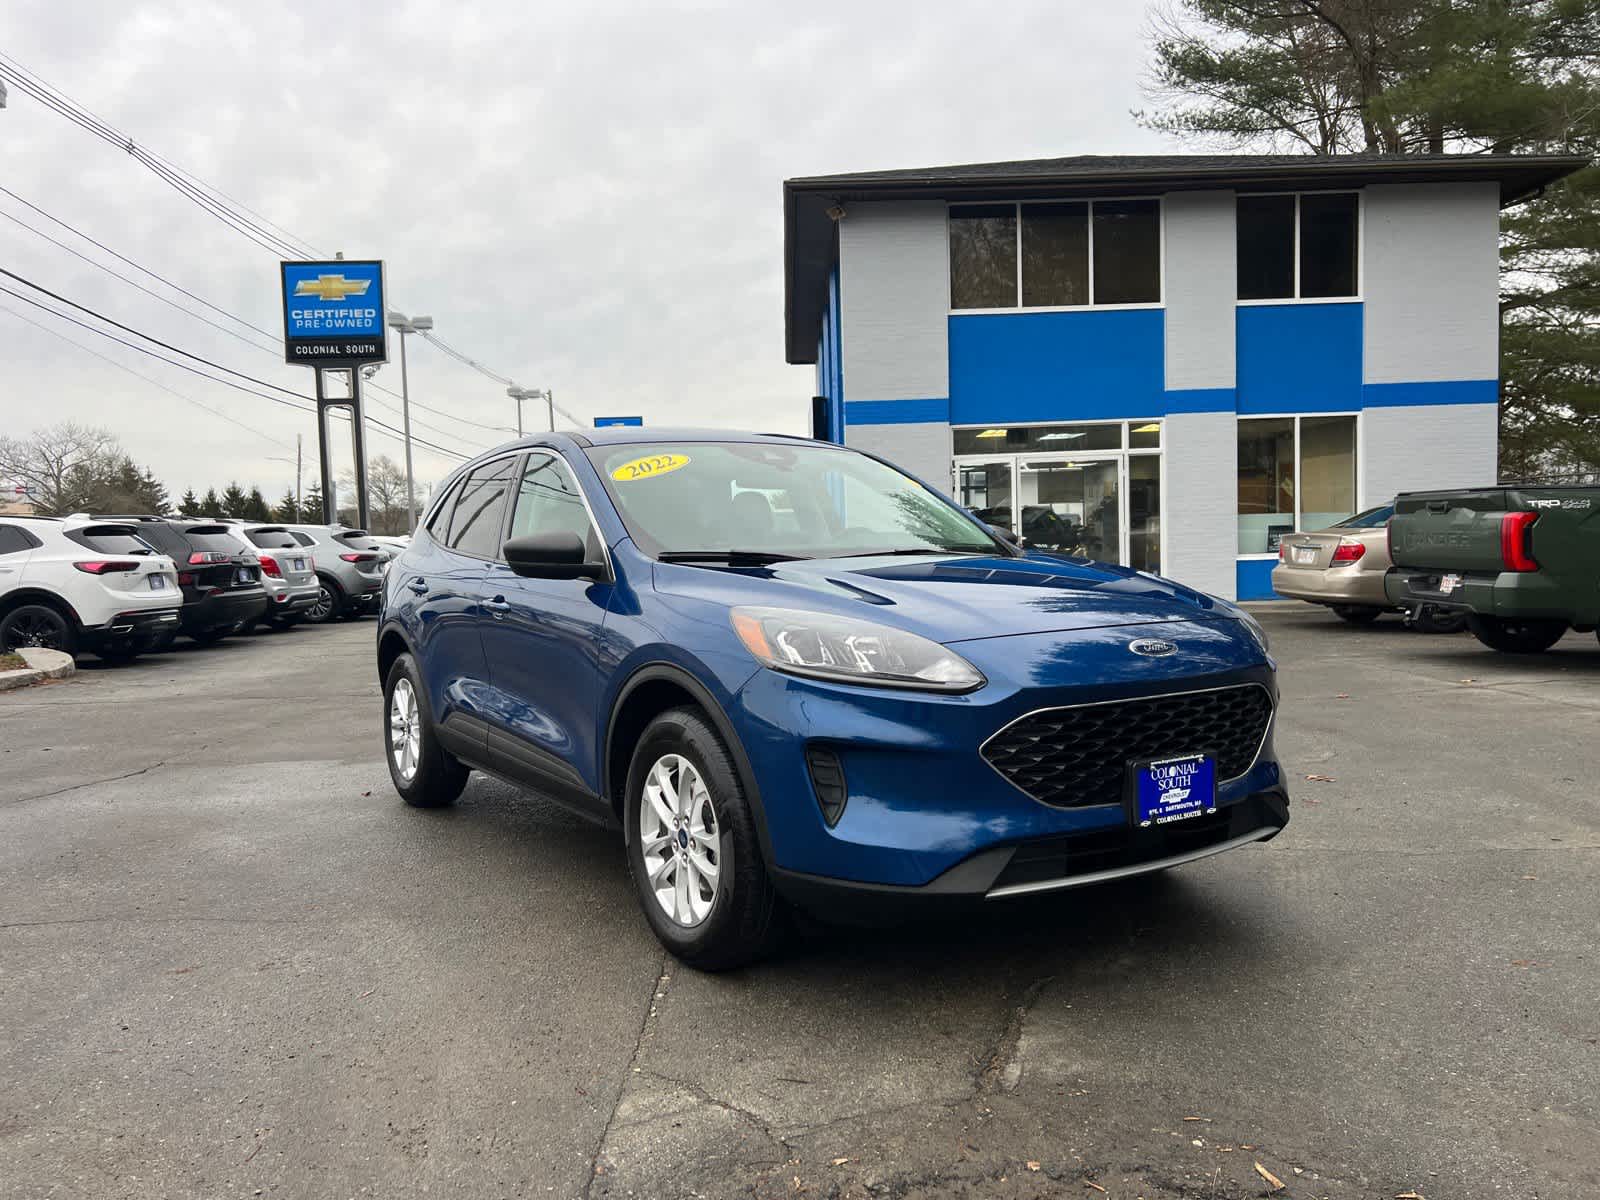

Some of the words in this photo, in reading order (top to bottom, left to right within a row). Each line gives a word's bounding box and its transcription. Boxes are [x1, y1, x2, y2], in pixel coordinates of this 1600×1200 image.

[291, 309, 376, 319] CERTIFIED
[296, 319, 373, 328] PRE-OWNED
[295, 346, 341, 354] COLONIAL
[346, 345, 376, 353] SOUTH
[625, 456, 677, 478] 2022
[1527, 499, 1561, 509] TRD
[1151, 763, 1199, 780] COLONIAL
[1158, 775, 1191, 790] SOUTH
[1163, 791, 1188, 800] CHEVROLET
[1156, 813, 1183, 824] COLONIAL
[1183, 809, 1202, 819] SOUTH
